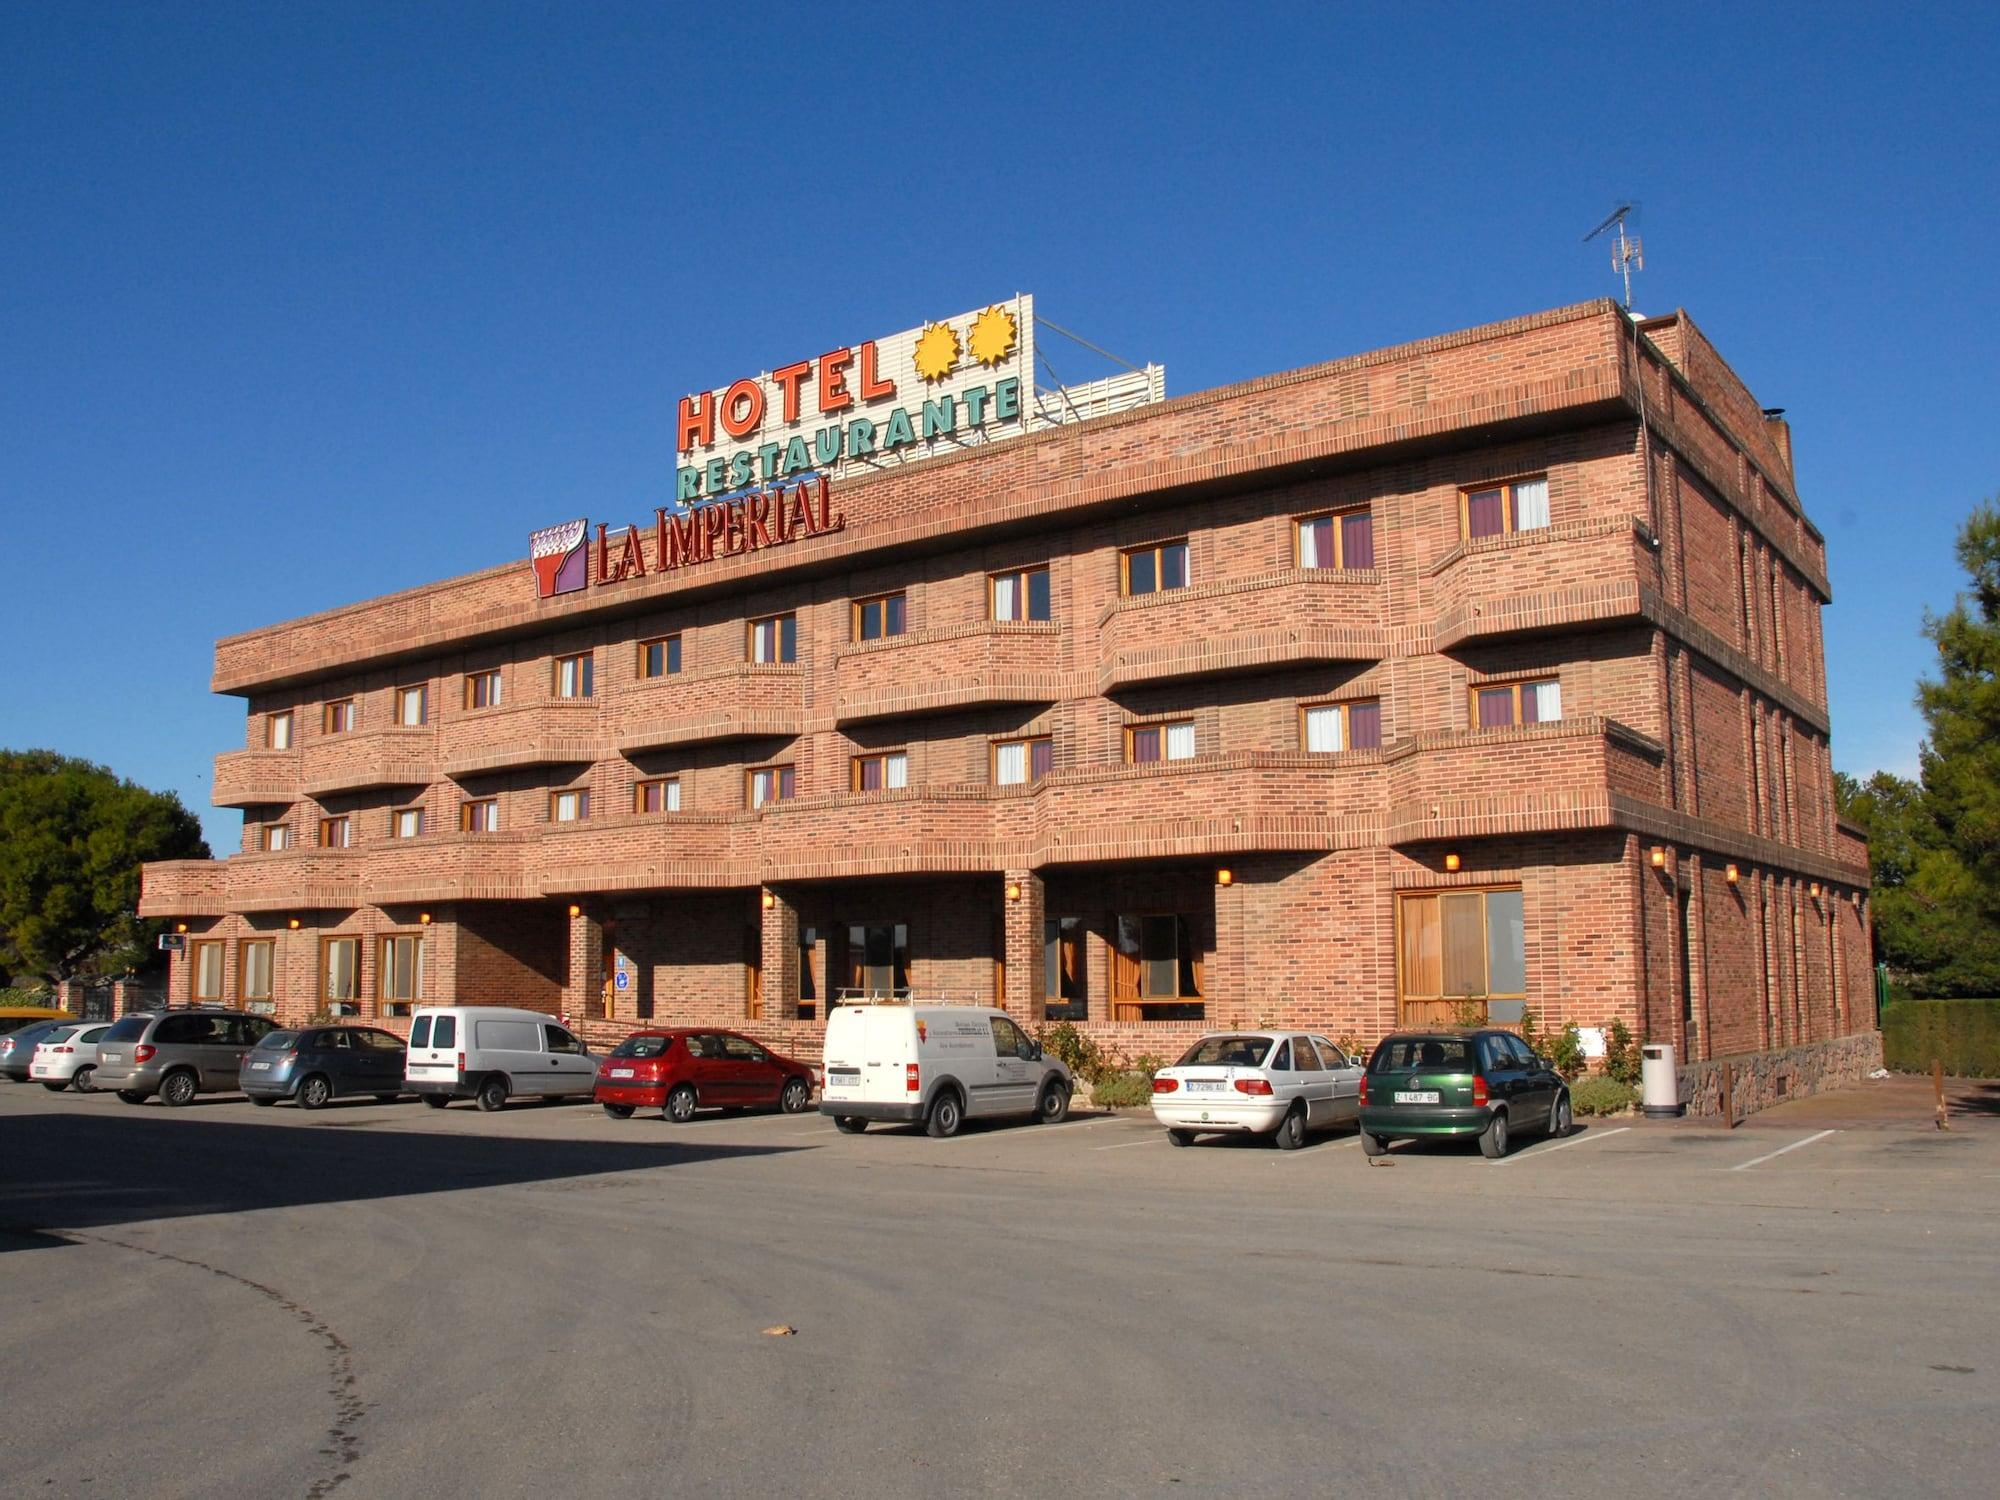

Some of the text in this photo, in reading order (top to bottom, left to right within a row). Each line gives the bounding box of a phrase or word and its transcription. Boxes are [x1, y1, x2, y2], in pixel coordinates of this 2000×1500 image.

[677, 341, 893, 452] HOTEL
[677, 377, 1019, 501] RESTAURANTE
[594, 474, 846, 585] LA IMPERIAL
